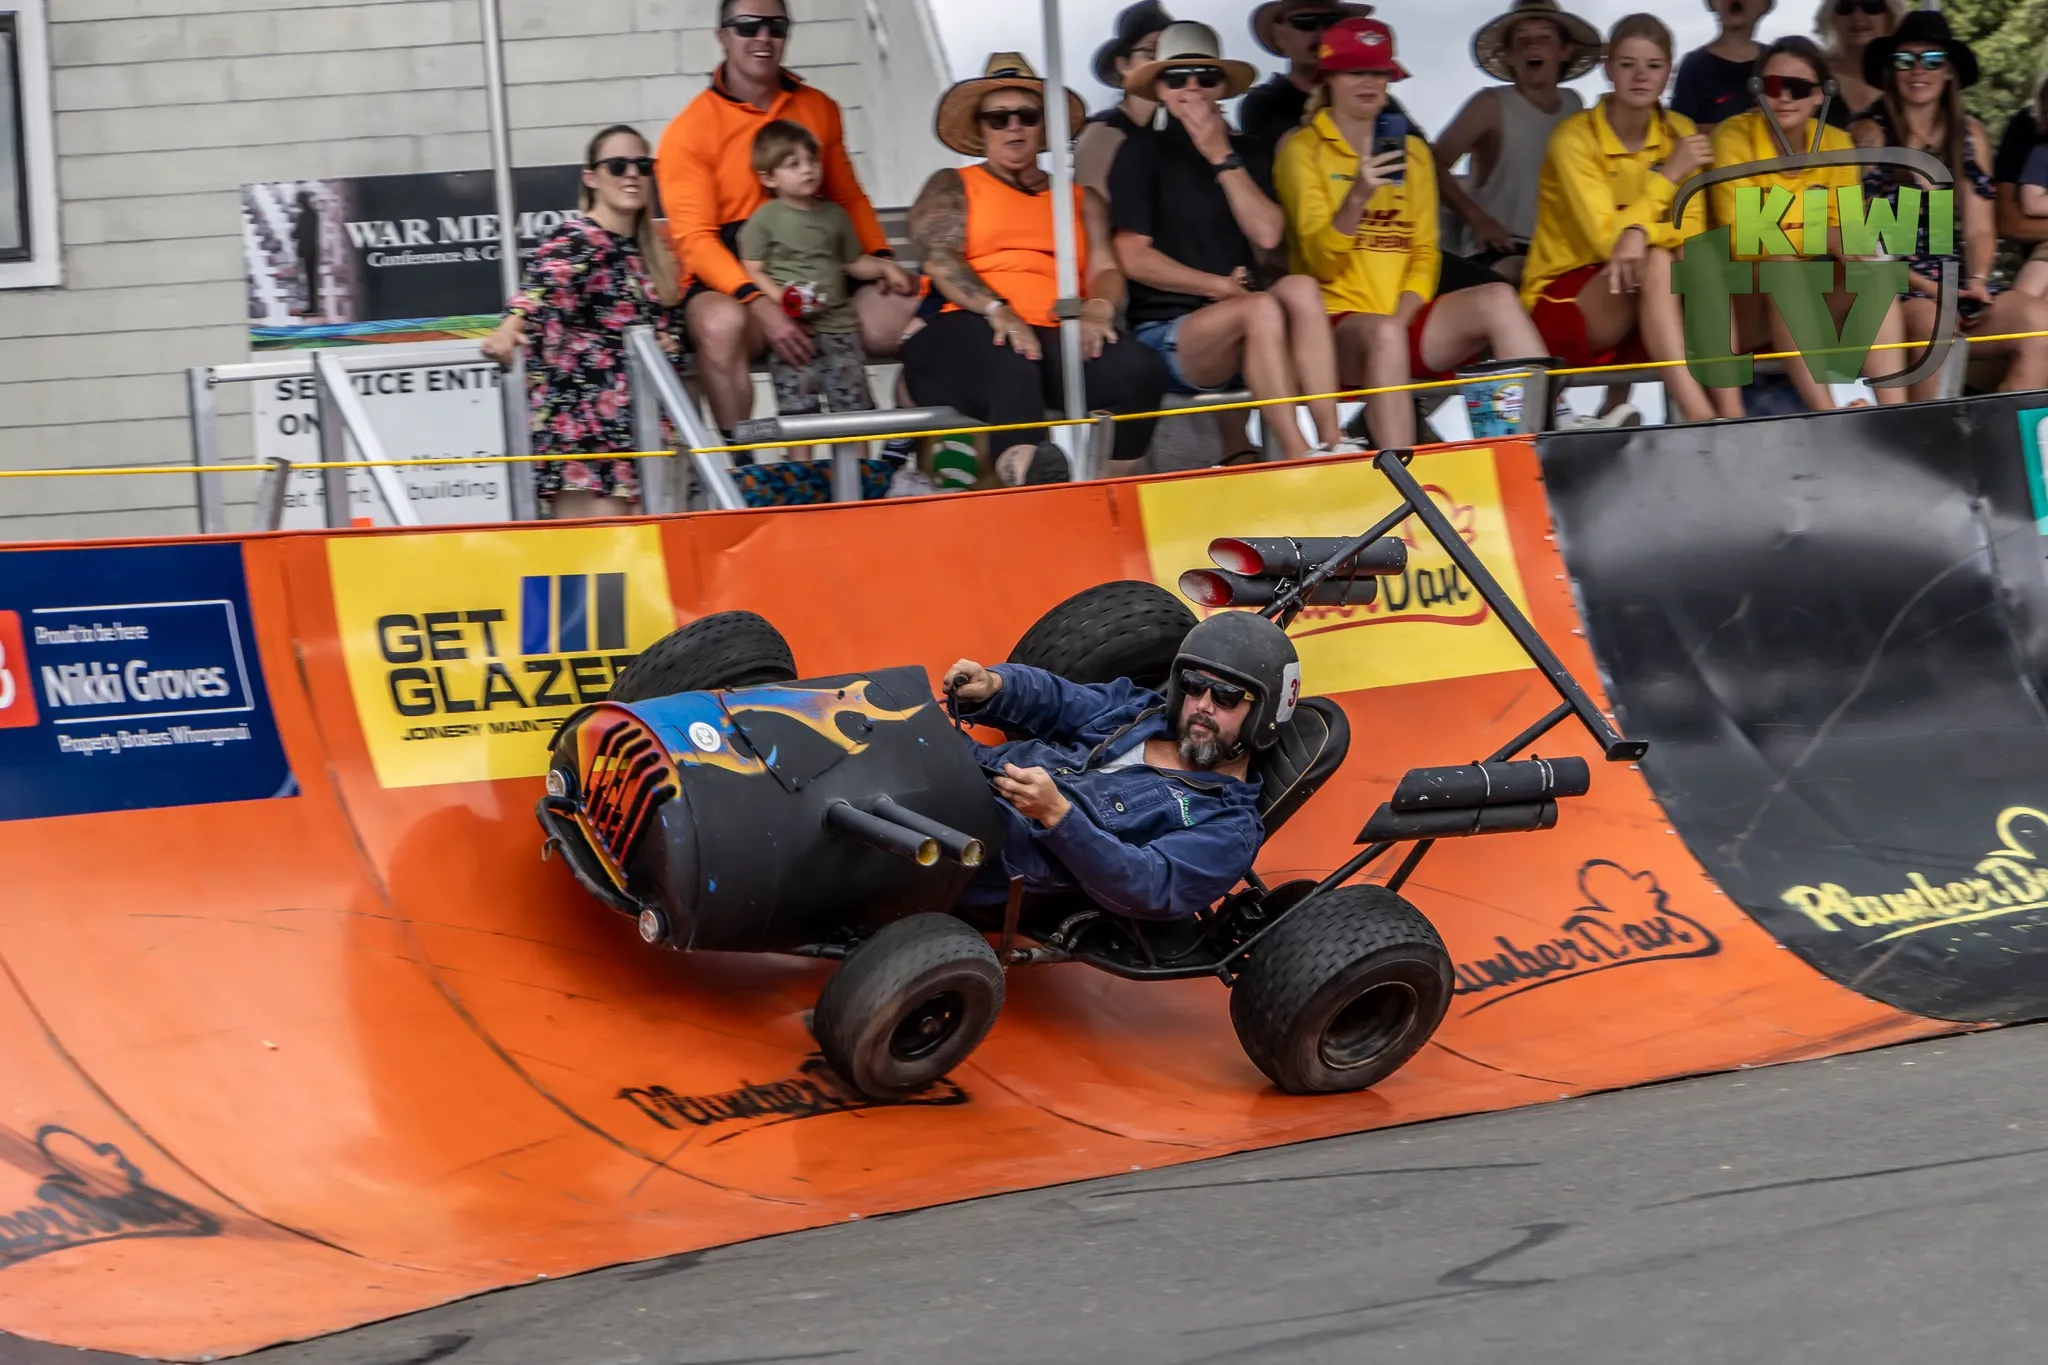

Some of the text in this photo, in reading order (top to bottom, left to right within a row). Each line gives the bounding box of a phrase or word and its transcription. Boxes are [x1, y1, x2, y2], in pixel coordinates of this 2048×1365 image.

[343, 219, 434, 248] WAR
[276, 372, 415, 401] SEICE
[376, 609, 508, 664] GET
[41, 662, 126, 707] Nikki
[124, 660, 230, 701] Groves
